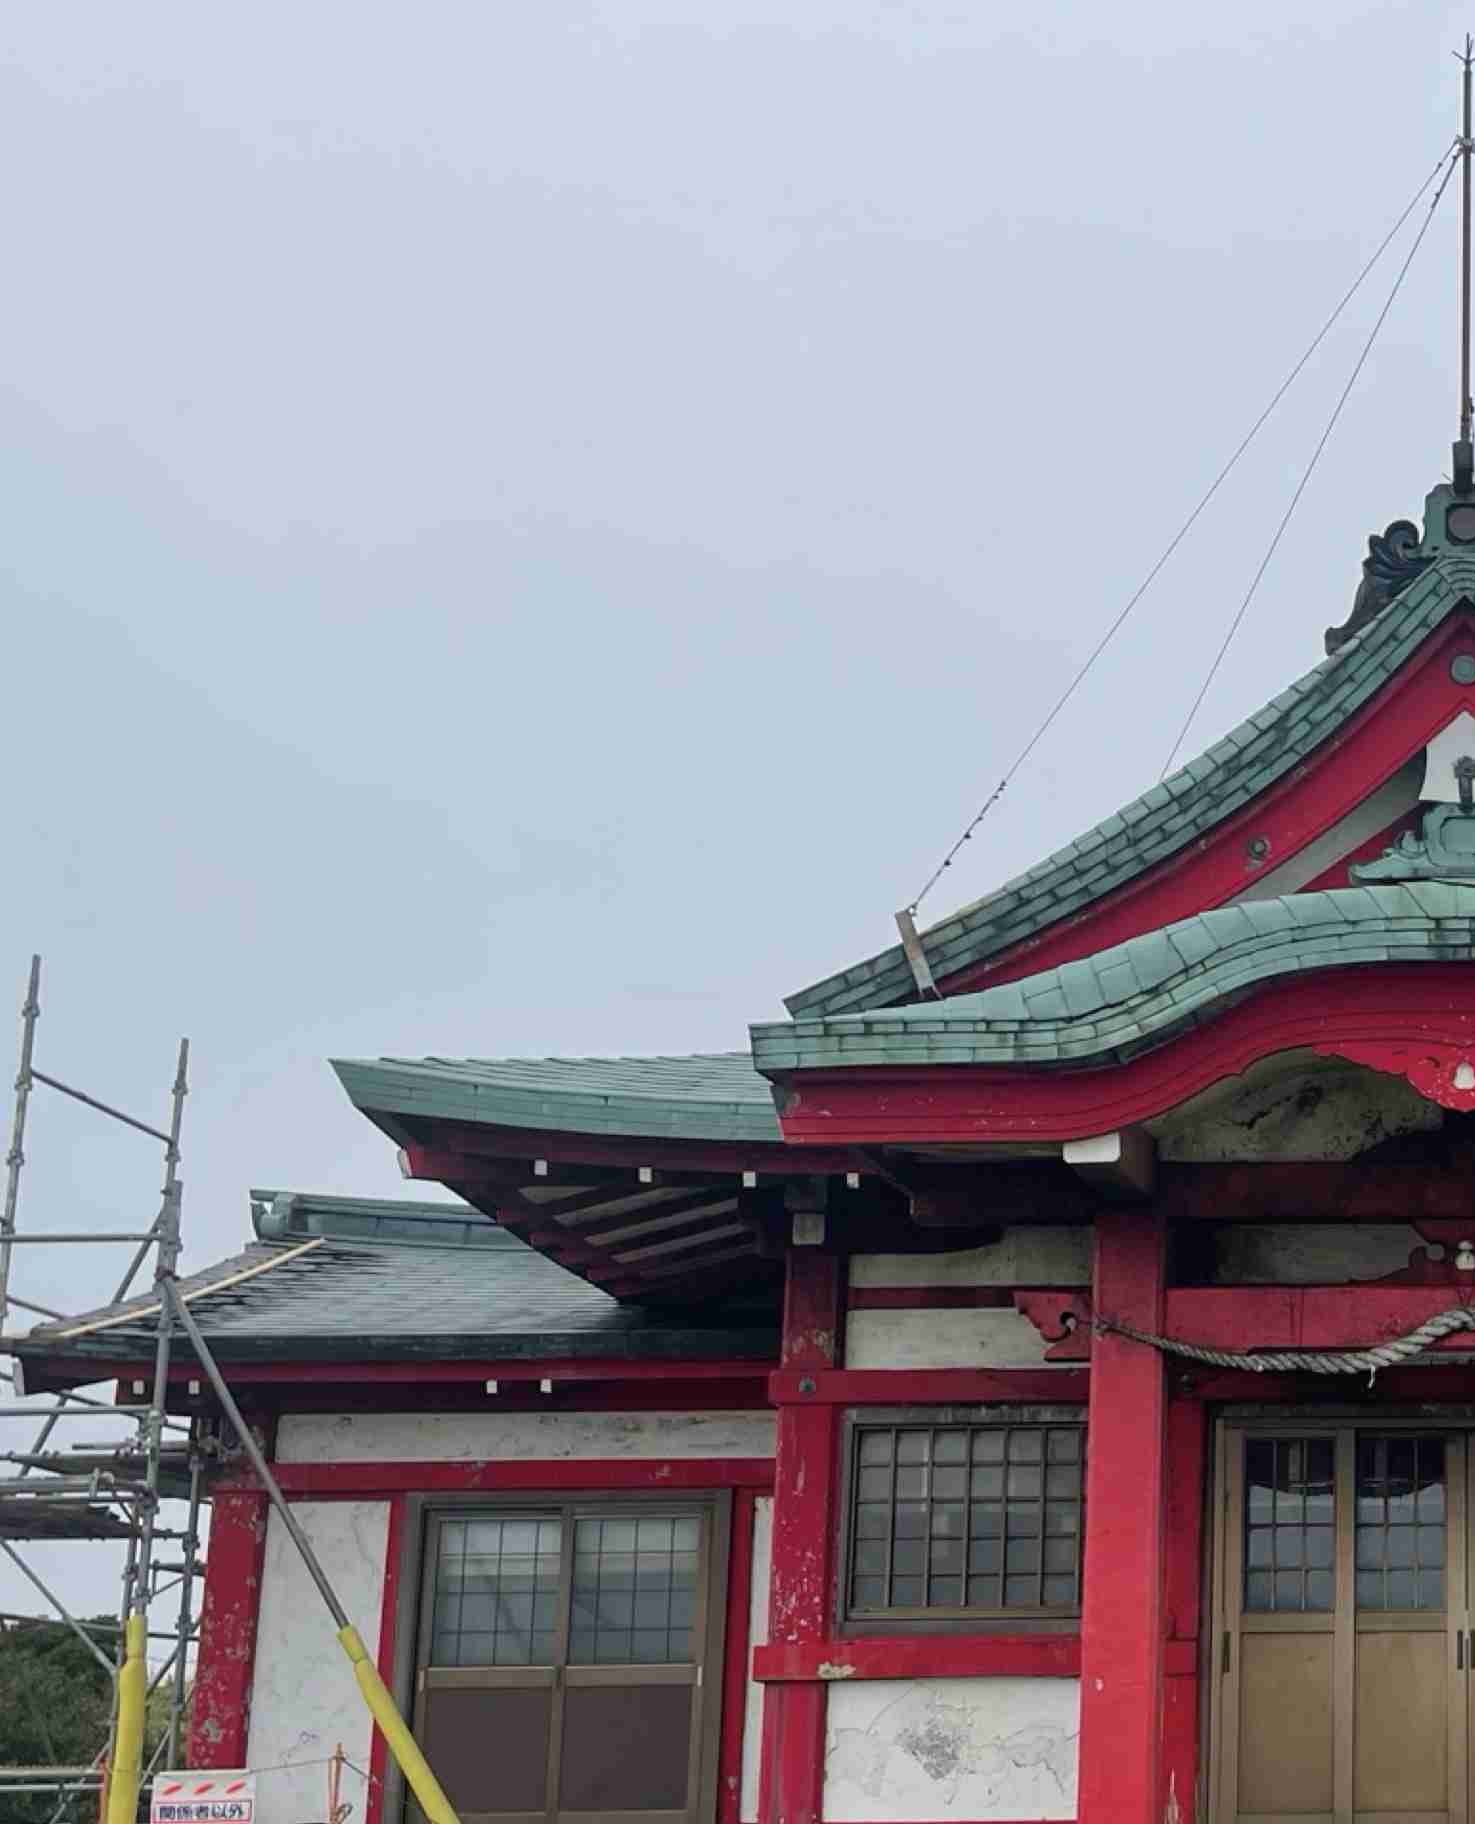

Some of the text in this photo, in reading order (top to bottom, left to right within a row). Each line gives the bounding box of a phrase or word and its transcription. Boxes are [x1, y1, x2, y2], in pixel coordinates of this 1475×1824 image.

[159, 1803, 243, 1820] 関係者以外
